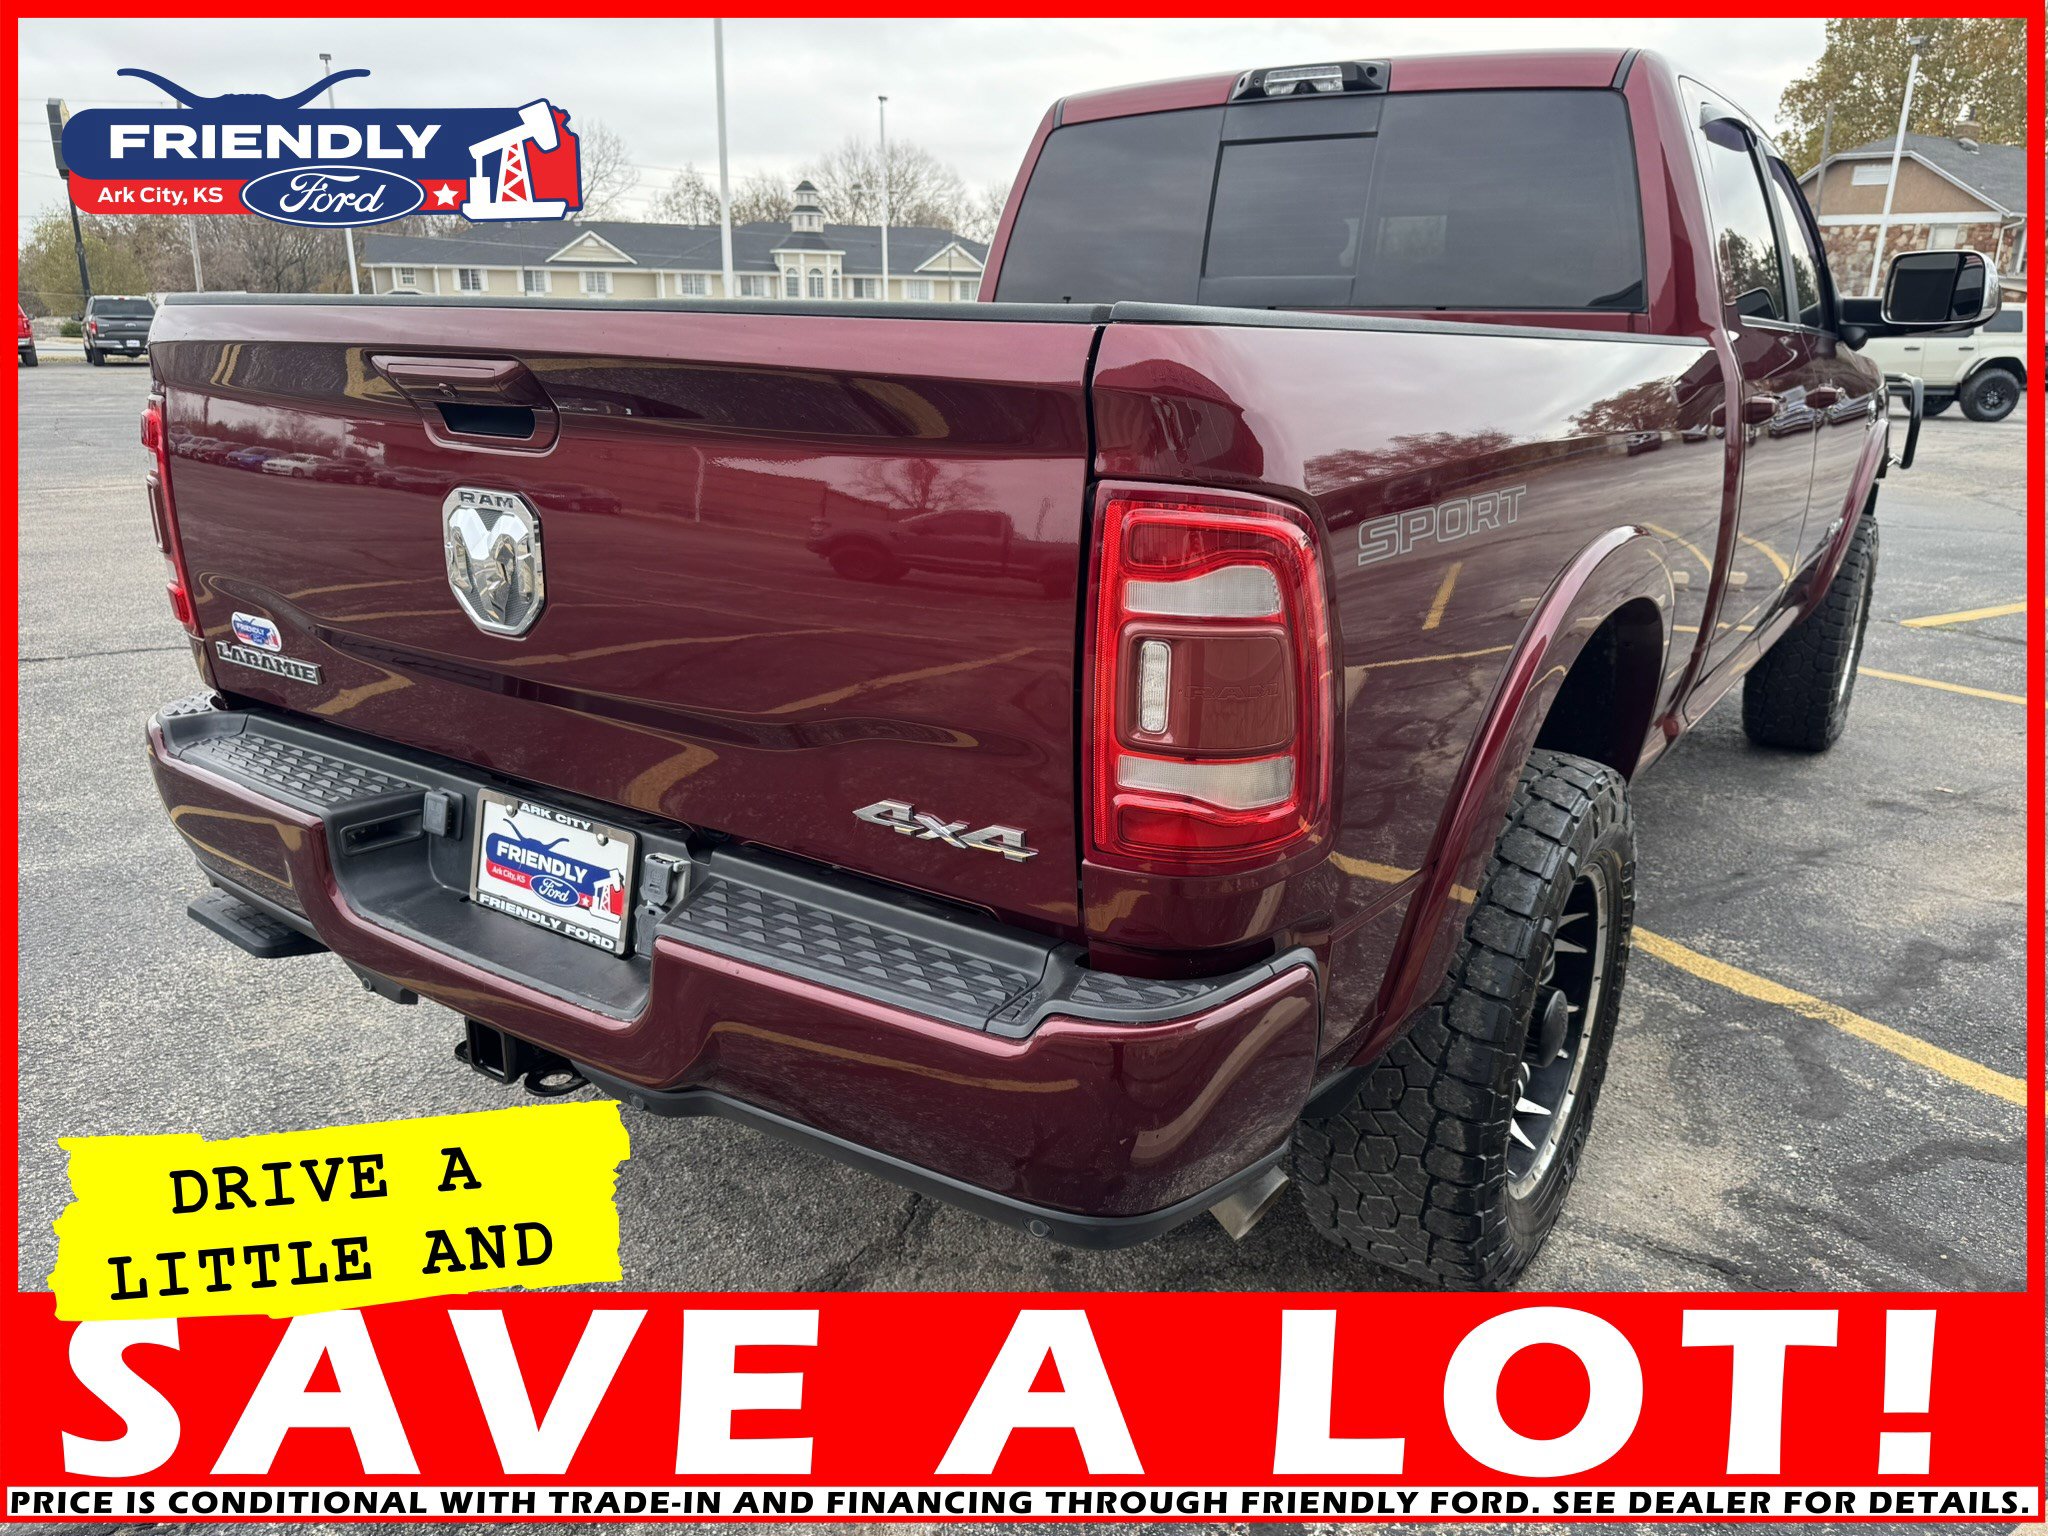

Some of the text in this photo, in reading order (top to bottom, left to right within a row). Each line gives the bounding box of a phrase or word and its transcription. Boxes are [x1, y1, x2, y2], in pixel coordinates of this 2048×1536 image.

[459, 491, 515, 509] RAM
[1357, 484, 1527, 567] SPORT
[215, 640, 321, 686] LARAMIE
[1183, 682, 1279, 701] RAM
[519, 802, 593, 831] ARK CITY
[491, 866, 503, 876] Ark
[516, 874, 526, 884] KS
[496, 840, 589, 884] FRIENDLY
[538, 877, 569, 902] Ford
[479, 893, 615, 950] FRIENDLY FORD
